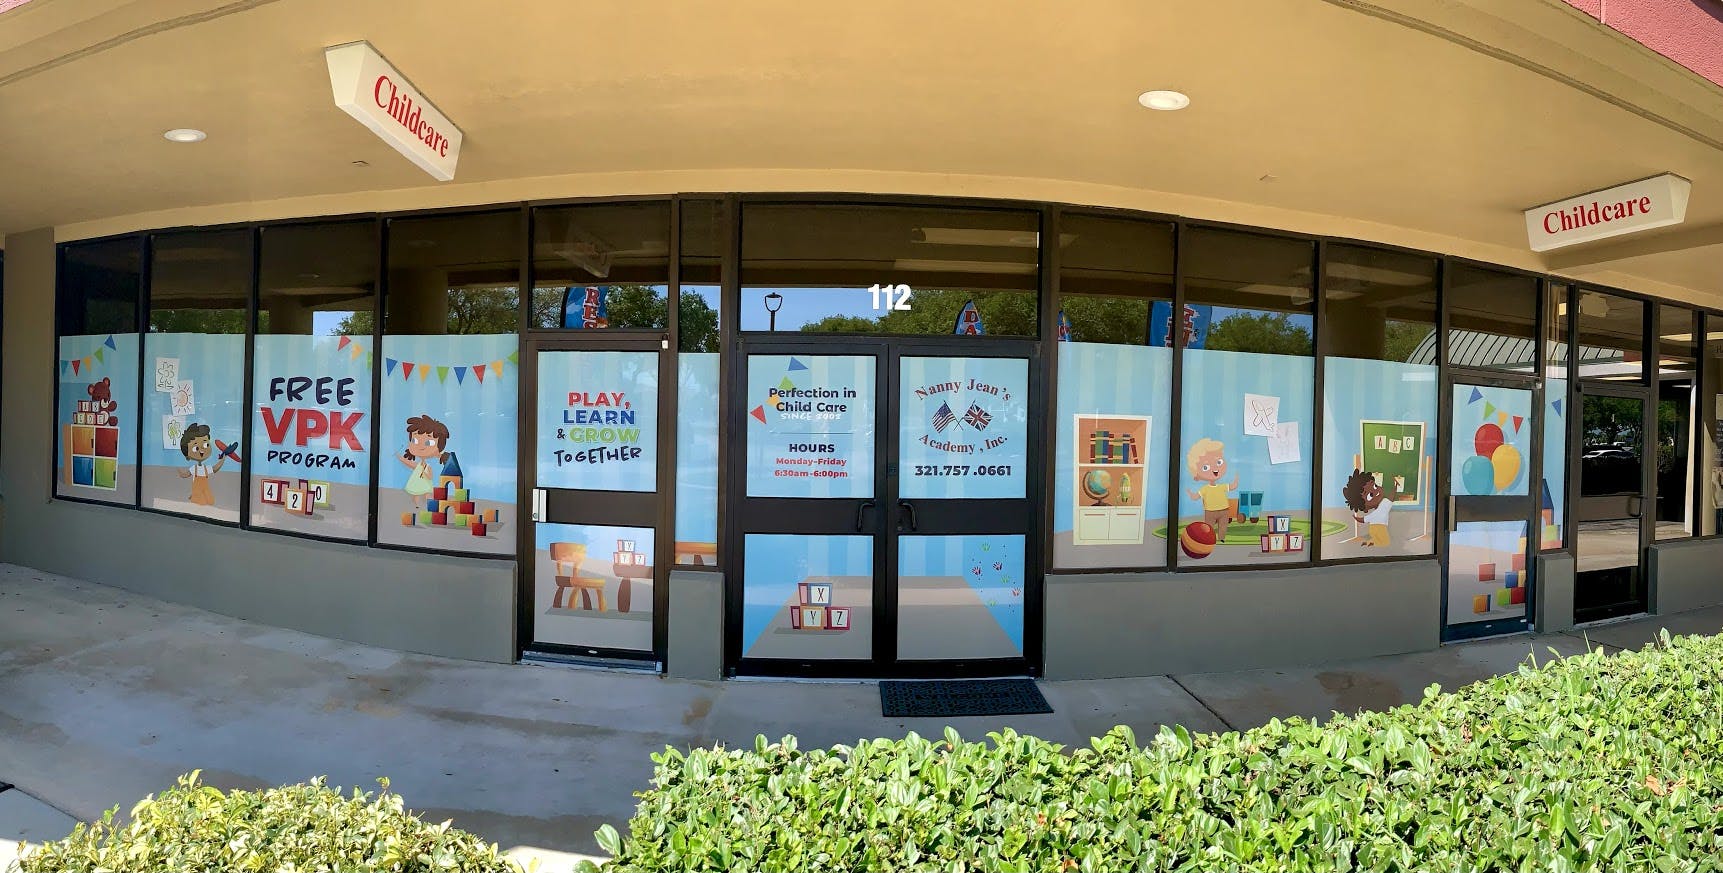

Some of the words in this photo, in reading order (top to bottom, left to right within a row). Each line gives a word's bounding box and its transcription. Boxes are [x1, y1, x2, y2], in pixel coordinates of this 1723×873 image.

[374, 75, 449, 158] Childcare
[1543, 195, 1651, 234] Childcare
[867, 283, 912, 311] 112
[269, 376, 355, 406] FREE
[769, 387, 839, 398] Perfection
[843, 387, 857, 398] in
[914, 381, 962, 401] Nanny
[966, 378, 1012, 401] Jean's
[568, 392, 631, 409] PLAY,
[776, 401, 812, 412] Child
[816, 402, 847, 412] Care
[563, 409, 635, 425] LEARN
[780, 412, 812, 420] SINCE
[260, 406, 365, 452] VPK
[556, 428, 566, 440] &
[569, 427, 641, 443] GROW
[789, 443, 835, 453] HOURS
[984, 434, 1008, 450] Inc.
[267, 450, 356, 470] PROGRAM
[266, 484, 274, 499] 4
[291, 493, 299, 509] 2
[817, 587, 825, 602] X
[810, 610, 817, 626] Y
[836, 610, 844, 626] Z
